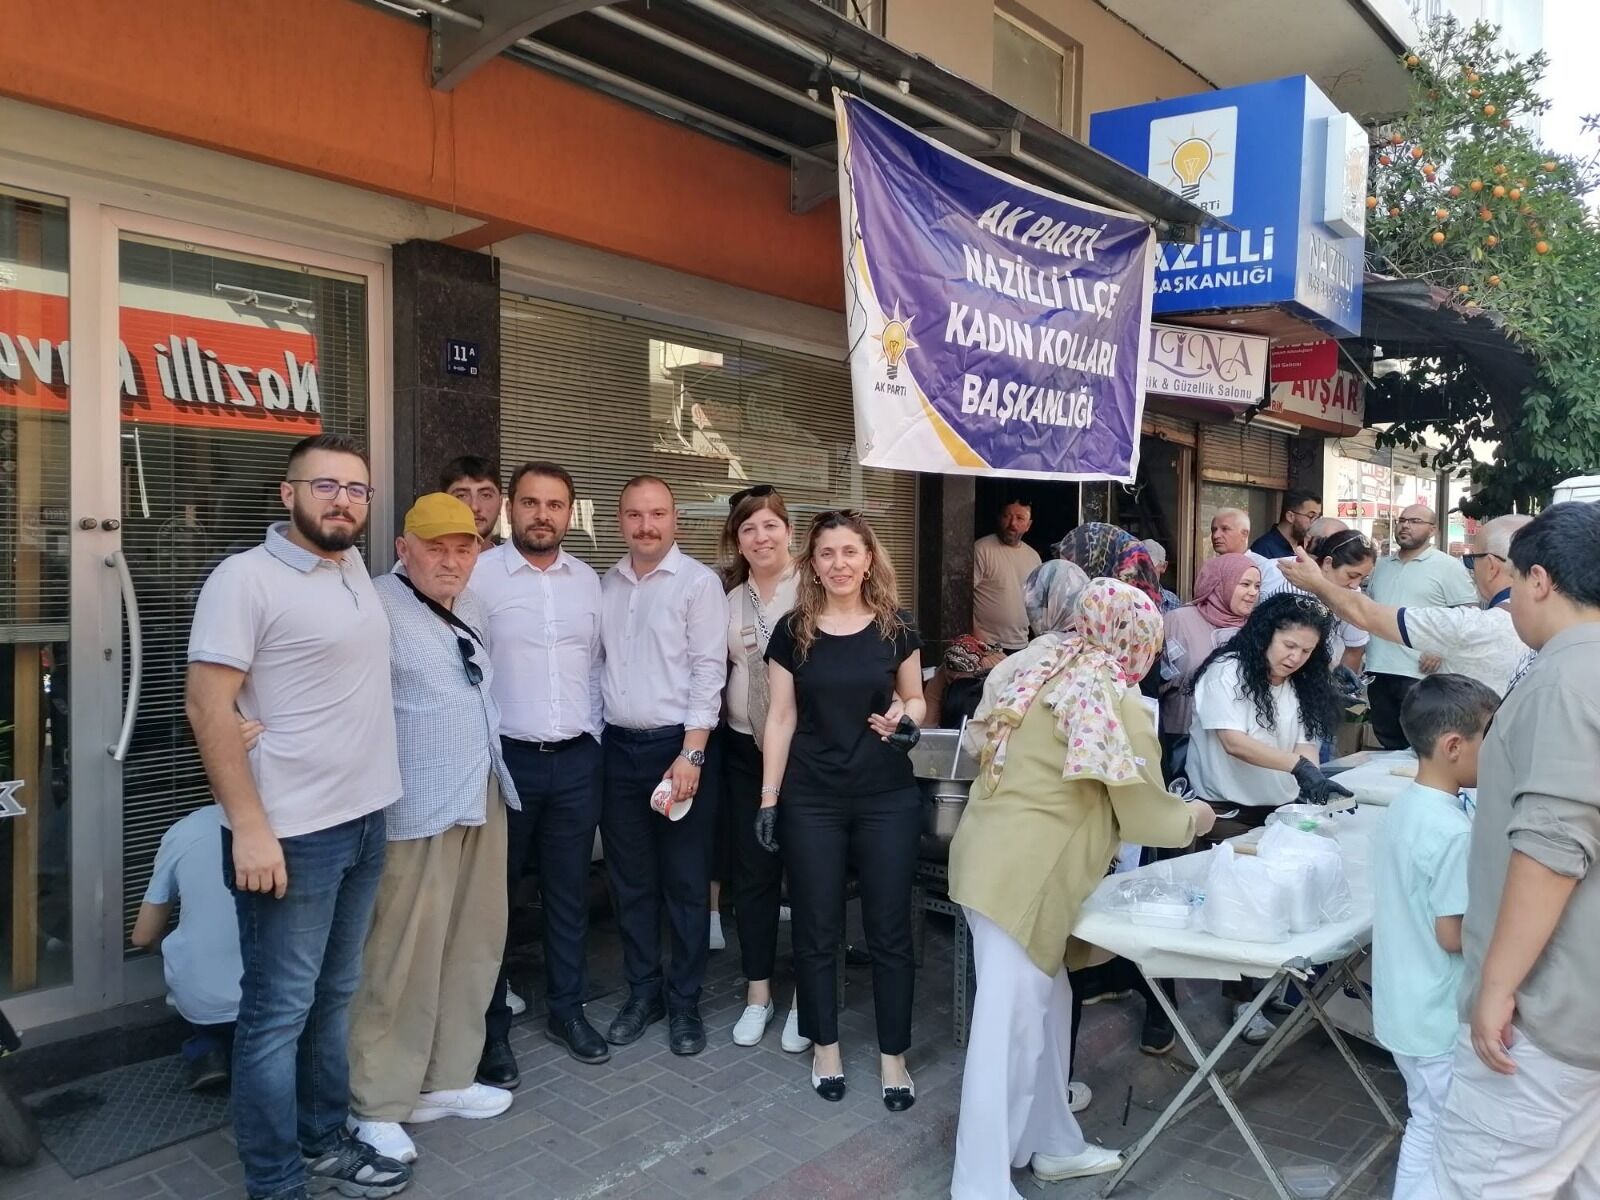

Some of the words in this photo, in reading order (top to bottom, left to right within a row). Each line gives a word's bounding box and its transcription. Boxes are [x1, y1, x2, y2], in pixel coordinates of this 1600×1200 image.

[977, 200, 1031, 246] AK
[1022, 209, 1107, 261] PARTİ
[963, 243, 1062, 309] NAZİLLİ
[1064, 270, 1121, 323] İLÇE
[454, 345, 468, 362] 11
[469, 347, 476, 357] A
[945, 302, 1034, 361] KADIN
[1038, 326, 1118, 377] KOLLARI
[875, 381, 886, 392] AK
[961, 373, 1094, 430] BAŞKANLIĞI
[1162, 378, 1169, 390] &
[1174, 378, 1215, 396] Güzellik
[1218, 384, 1253, 399] Salonu
[1291, 375, 1359, 414] AVŞAR
